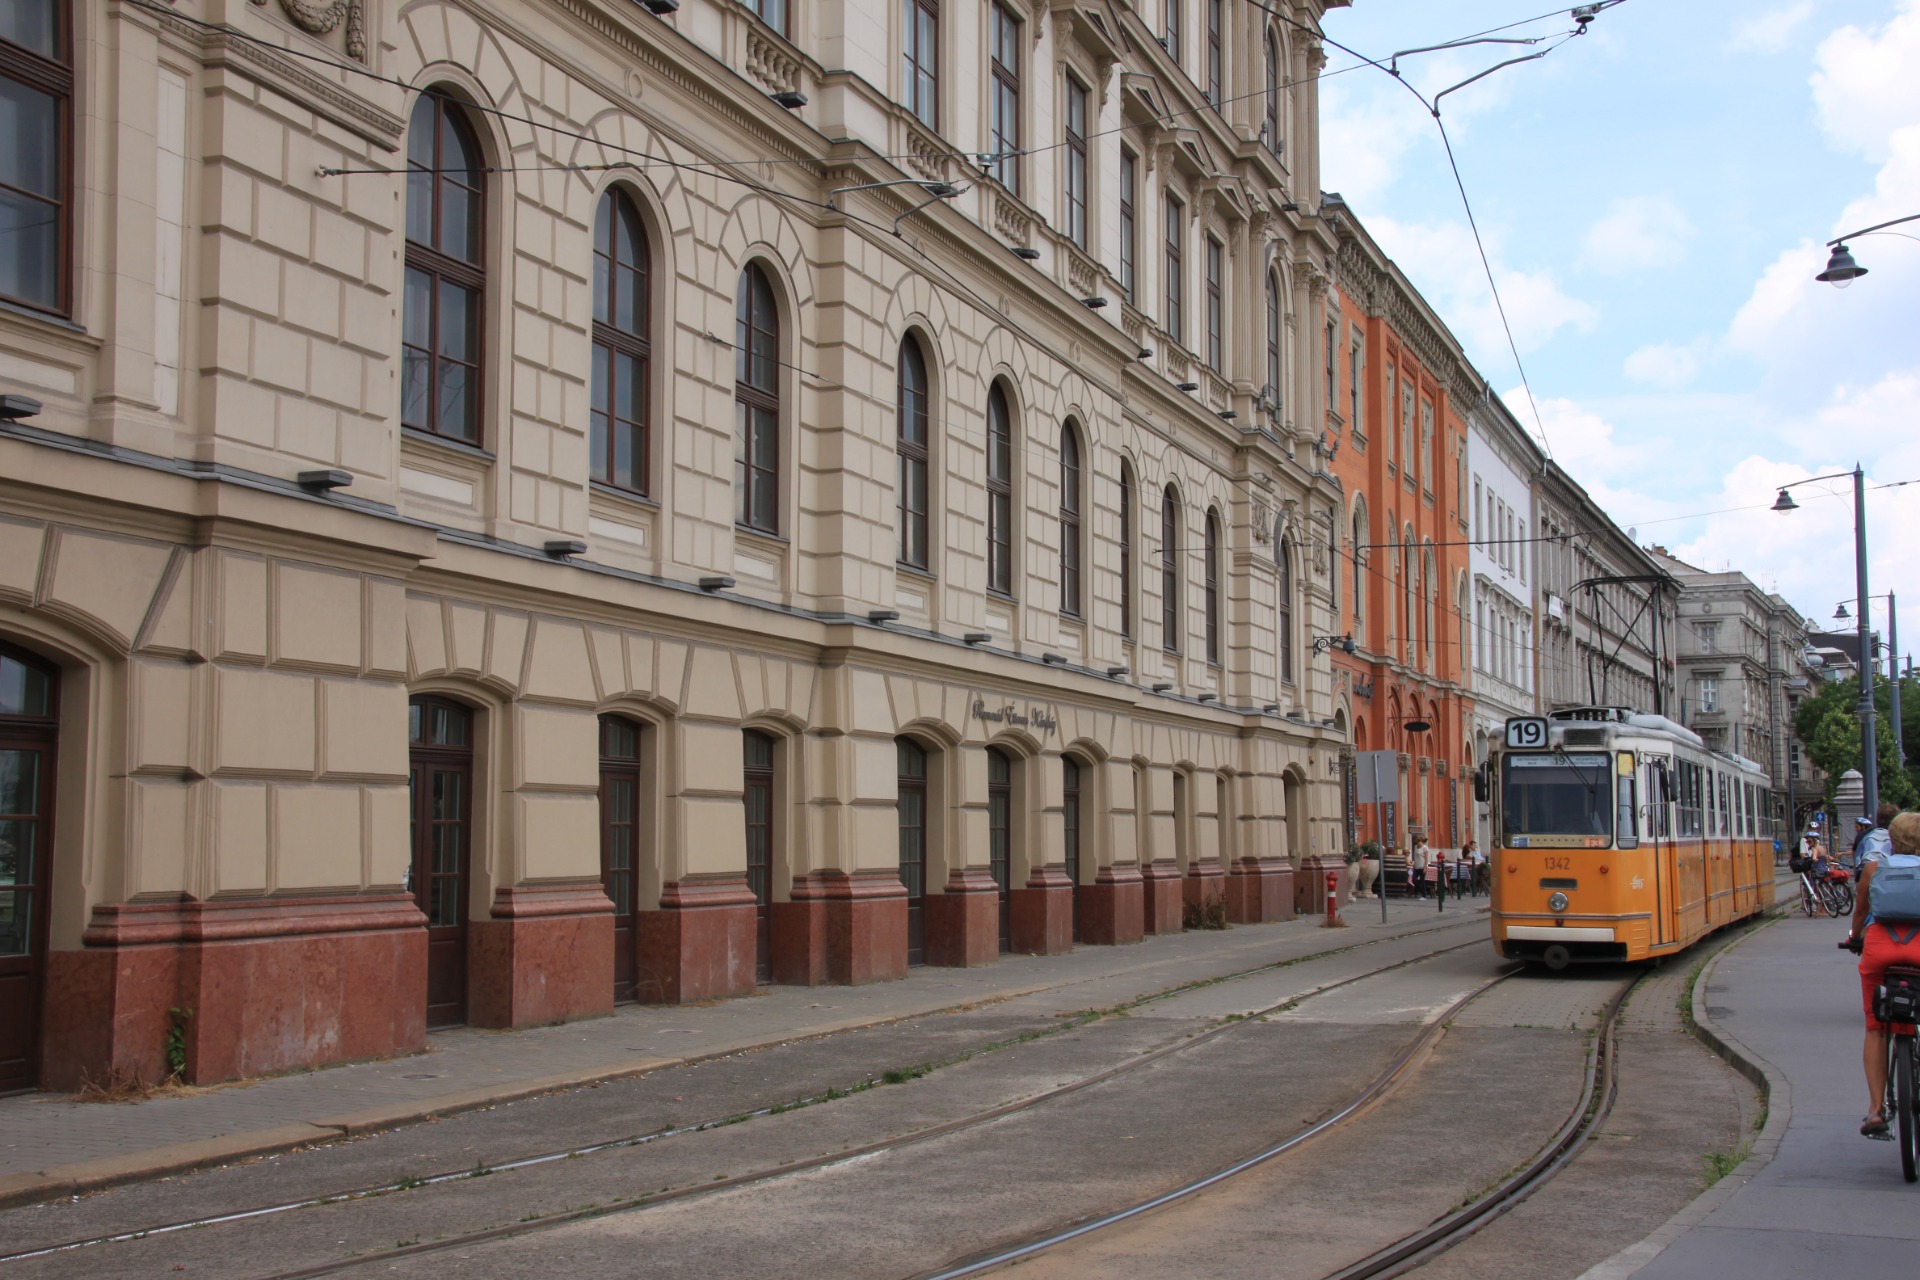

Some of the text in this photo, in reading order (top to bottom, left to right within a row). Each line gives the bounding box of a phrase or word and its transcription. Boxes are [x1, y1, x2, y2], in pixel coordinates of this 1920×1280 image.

[1511, 723, 1541, 744] 19
[1554, 757, 1565, 765] 19
[1544, 857, 1570, 870] 1342
